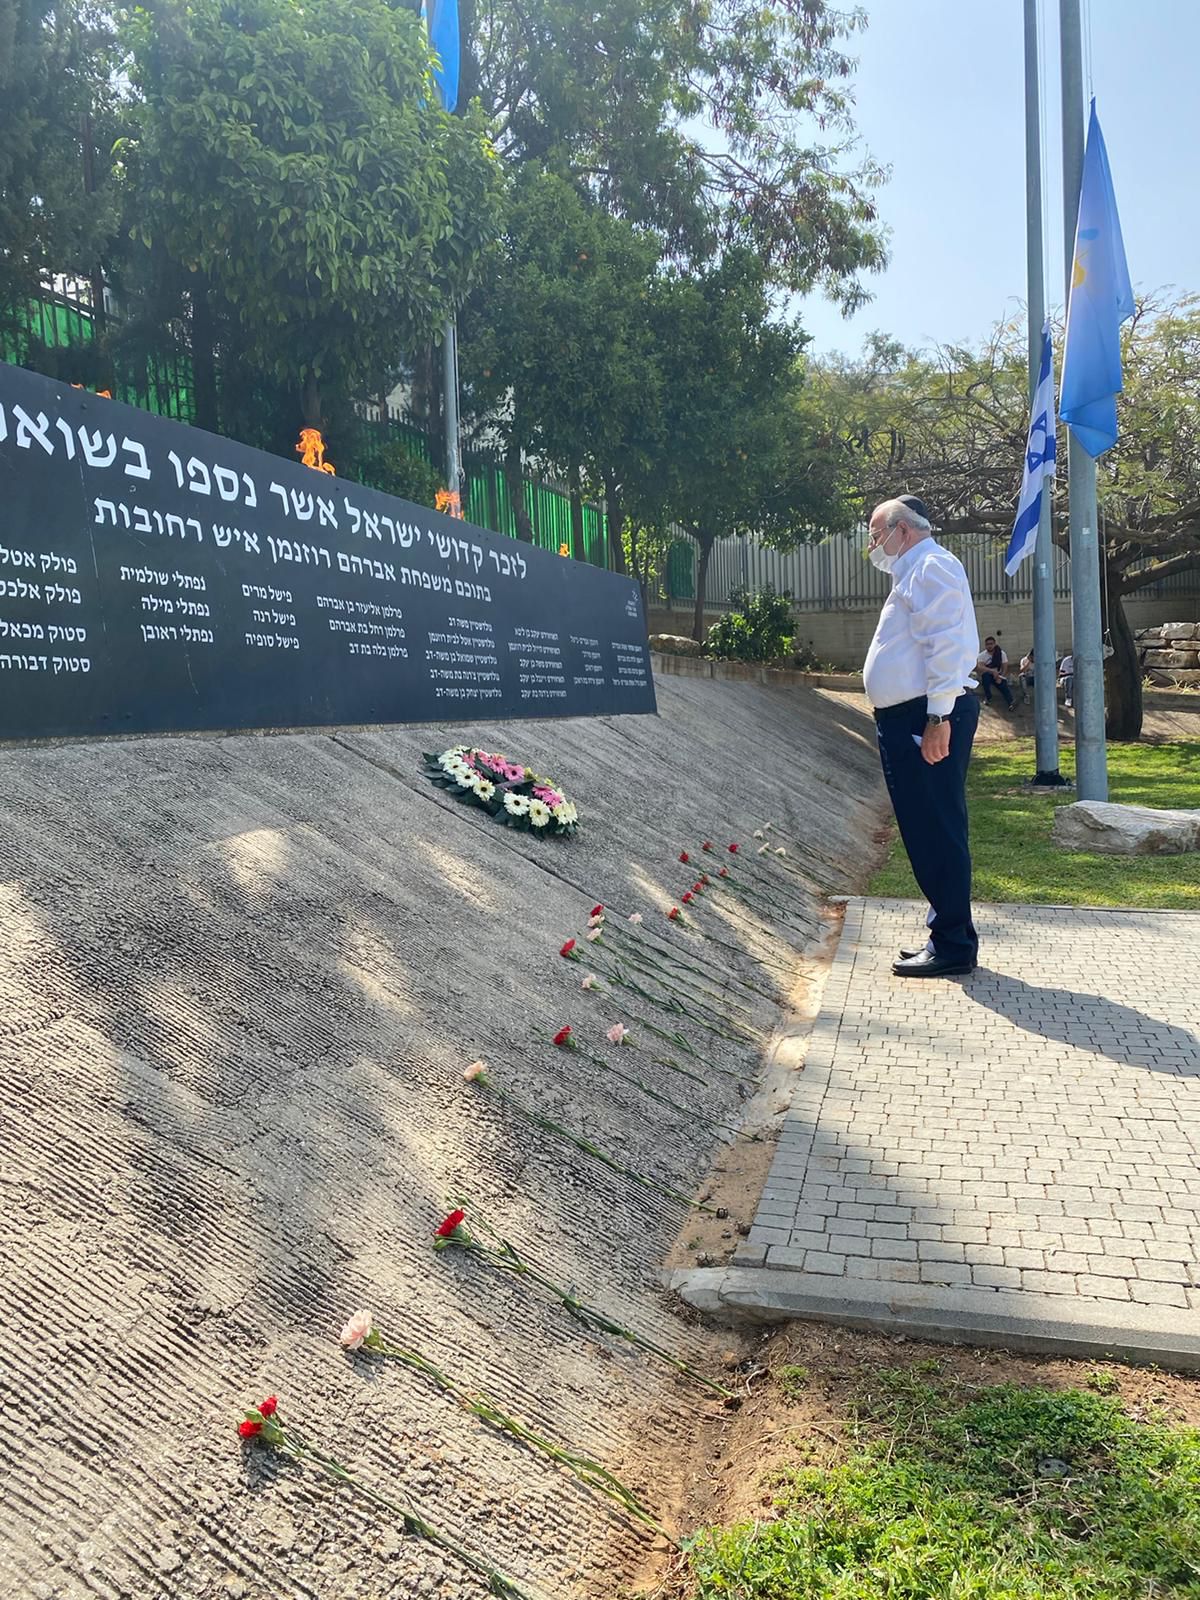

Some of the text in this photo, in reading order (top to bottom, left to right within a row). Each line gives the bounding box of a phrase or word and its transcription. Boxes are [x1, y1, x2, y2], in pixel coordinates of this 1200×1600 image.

[168, 450, 257, 508] נספו
[269, 481, 338, 530] אשר
[345, 497, 421, 549] ישראל
[94, 497, 492, 602] בתוכם משפחת אברהם רוזנמן איש רחובות
[427, 529, 483, 574] קדושי
[40, 551, 77, 574] פולק
[489, 549, 527, 580] לזכר
[120, 565, 207, 591] נפתלי שולמית
[44, 583, 82, 605] פולק
[242, 583, 293, 603] פישל מרים
[141, 594, 211, 617] נפתלי מילה
[253, 608, 297, 626] פישל רנה
[316, 595, 403, 619] פרלמן אליעזר בן אברהם
[0, 618, 87, 643] סטוק מכאל
[140, 623, 214, 643] נפתלי ראובן
[329, 618, 406, 639] פרלמן רחל בת אברהם
[245, 632, 300, 649] פישל סופיה
[349, 642, 409, 659] פרלמן בלה בת דב
[0, 654, 91, 675] סטוק דבורה
